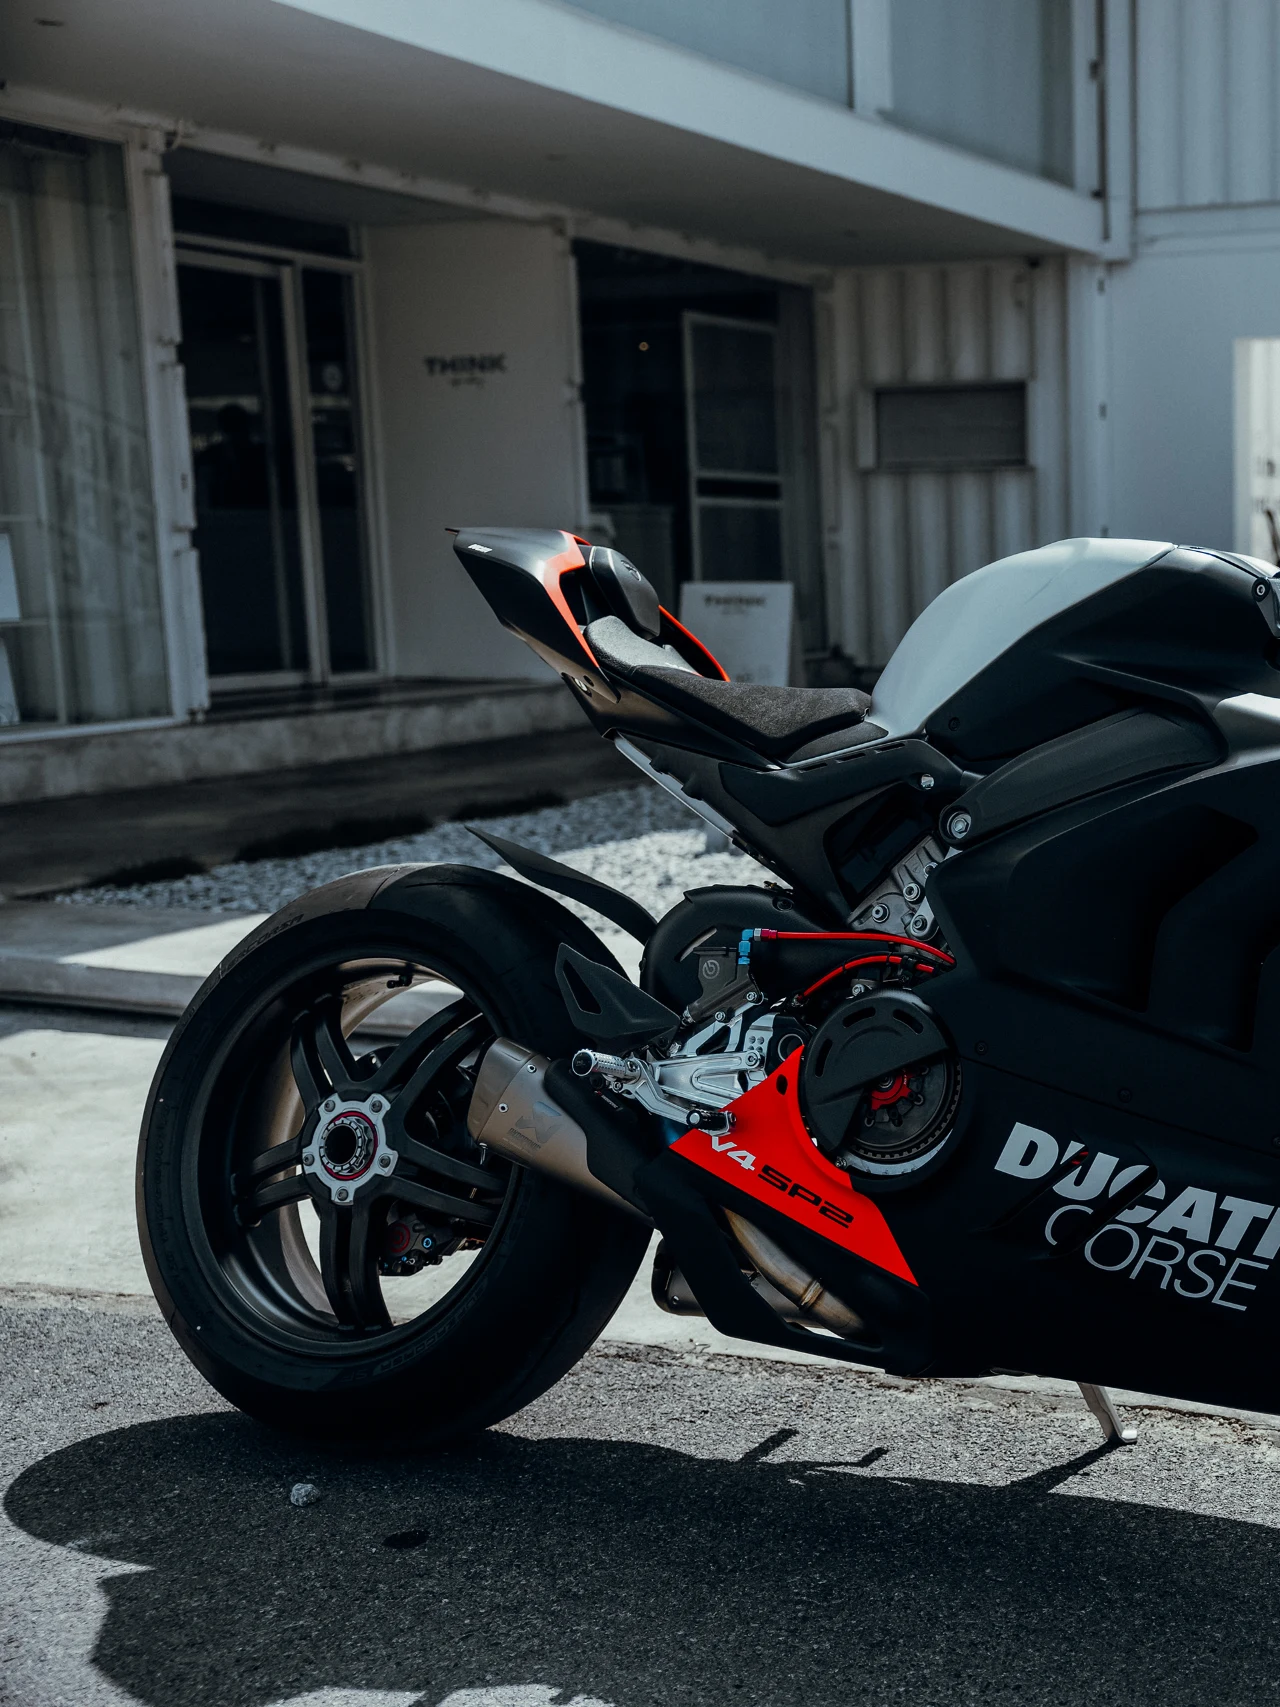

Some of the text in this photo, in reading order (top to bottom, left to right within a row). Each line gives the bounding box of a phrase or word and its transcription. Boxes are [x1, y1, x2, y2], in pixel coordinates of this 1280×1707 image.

[424, 353, 507, 376] THINK
[711, 1133, 855, 1229] V4 SP2
[1045, 1204, 1270, 1312] CORSE
